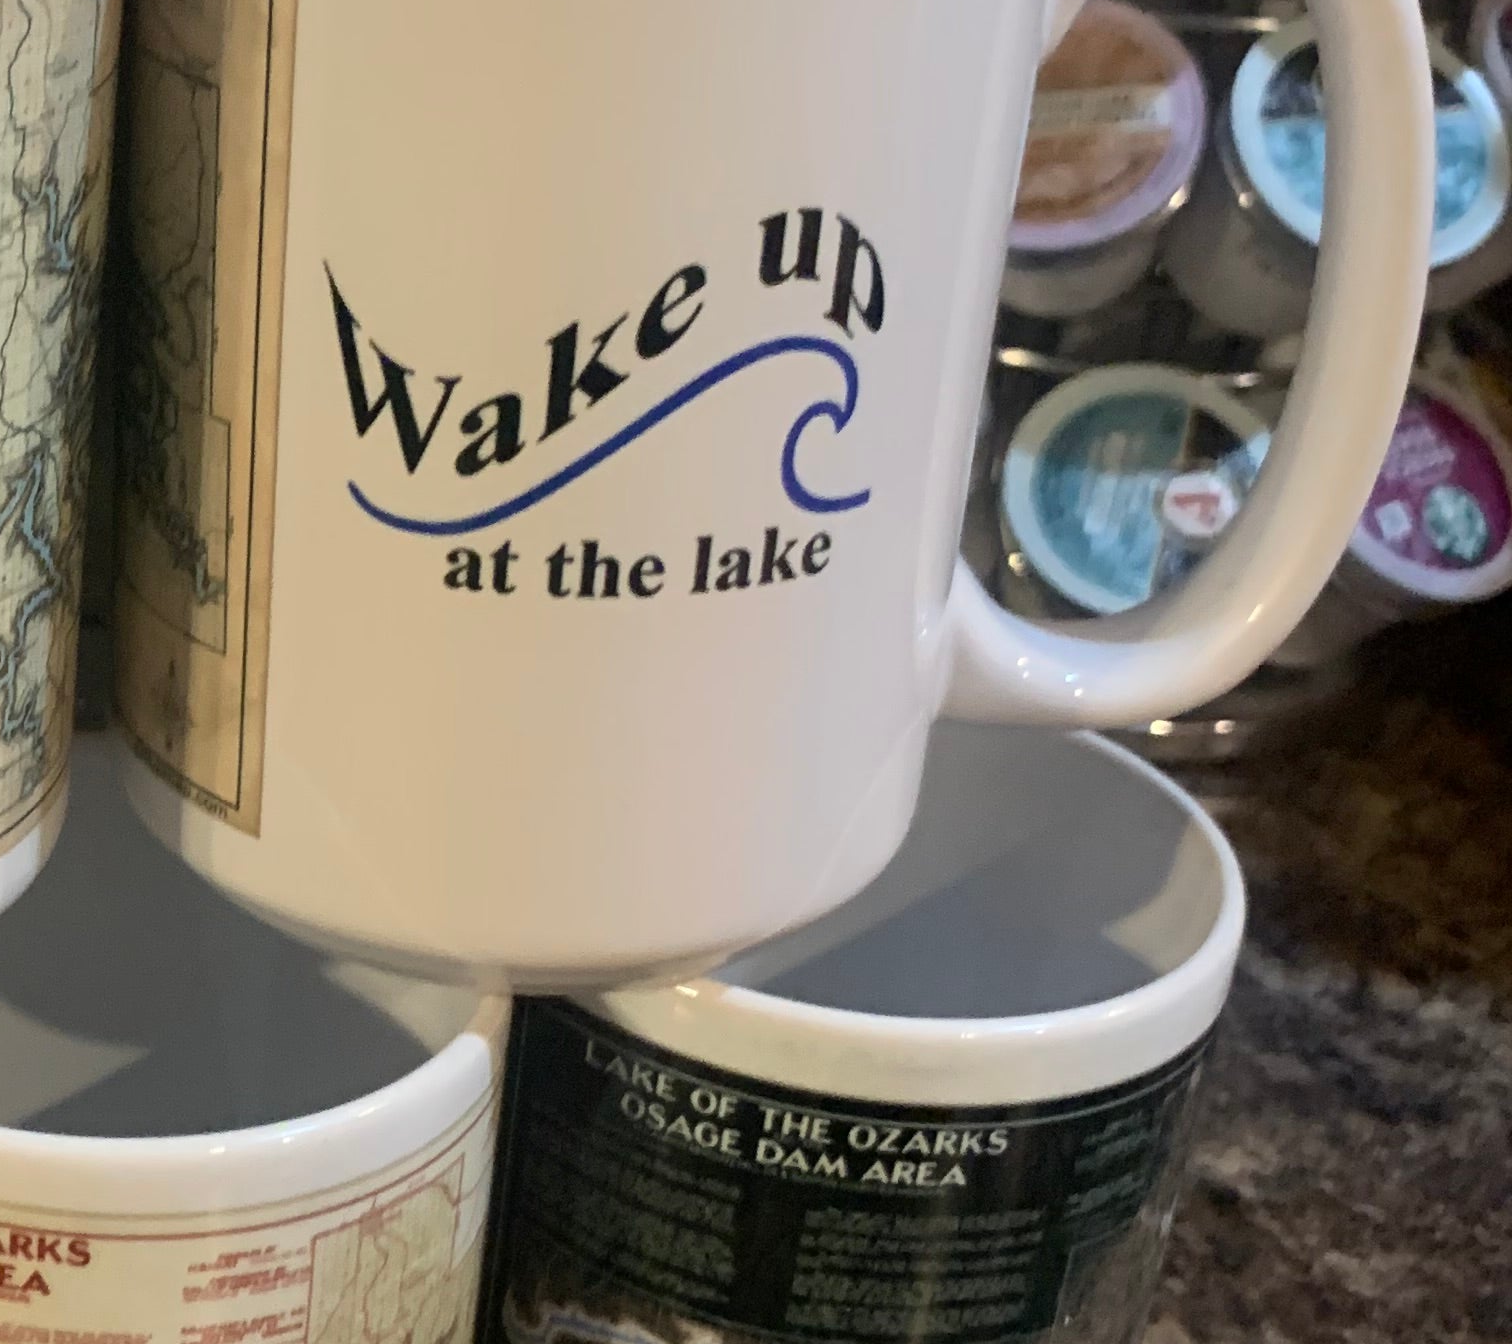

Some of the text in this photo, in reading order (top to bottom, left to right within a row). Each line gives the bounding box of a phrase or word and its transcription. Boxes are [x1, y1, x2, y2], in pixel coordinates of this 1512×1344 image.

[322, 207, 885, 478] Wake up
[443, 527, 833, 599] at the lake
[585, 1040, 1008, 1156] LAKE OF THE OZARKS
[620, 1091, 967, 1187] OSAGE DAM AREA
